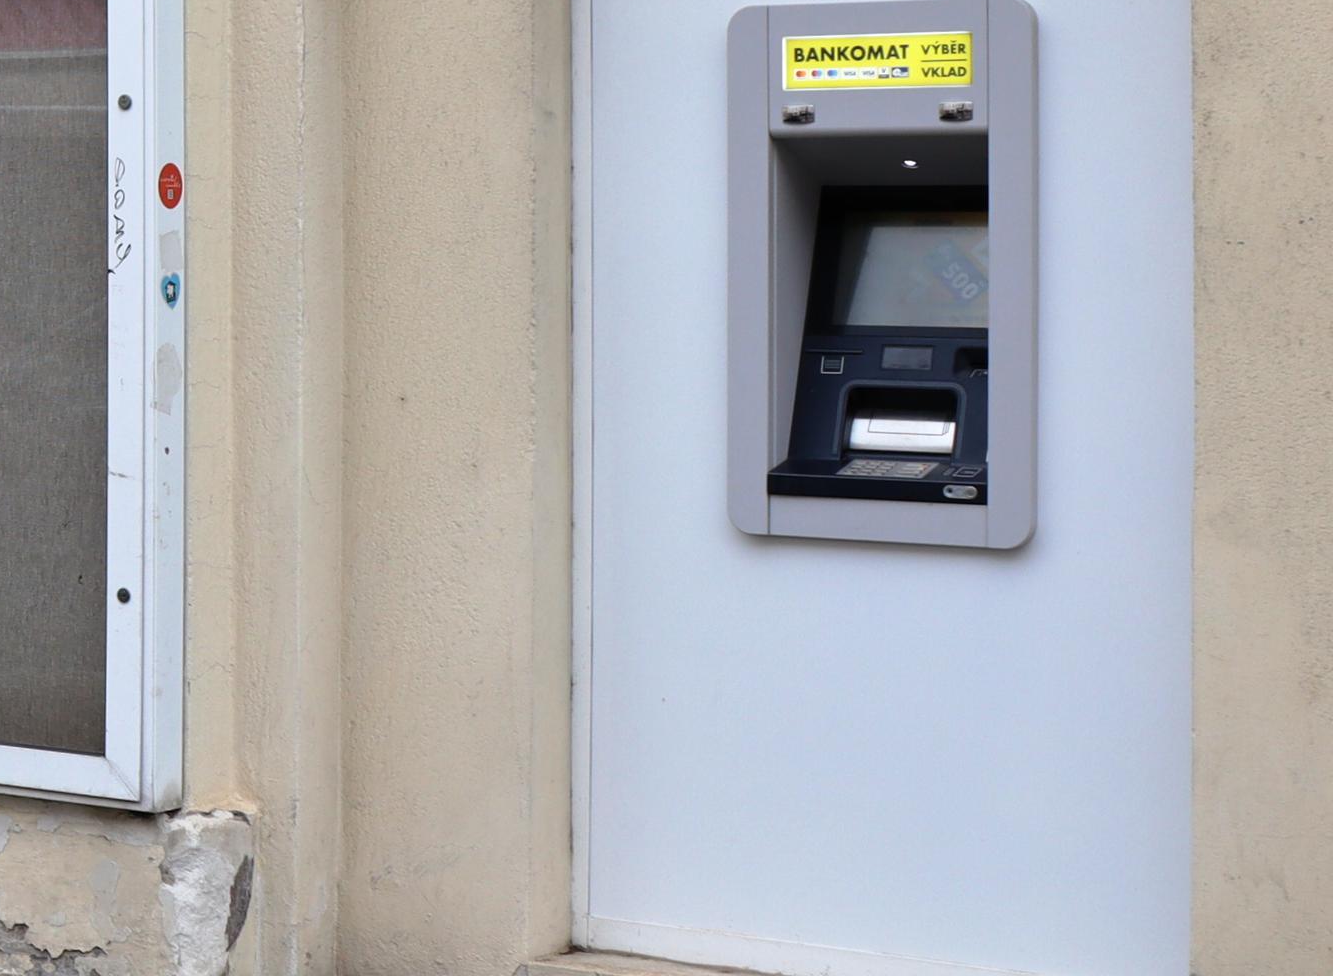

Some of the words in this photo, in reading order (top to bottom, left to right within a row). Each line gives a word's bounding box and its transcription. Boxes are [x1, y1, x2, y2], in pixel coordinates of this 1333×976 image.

[794, 45, 910, 63] BANKOMAT
[921, 40, 967, 55] VÝBĚR
[921, 67, 967, 78] VKLAD
